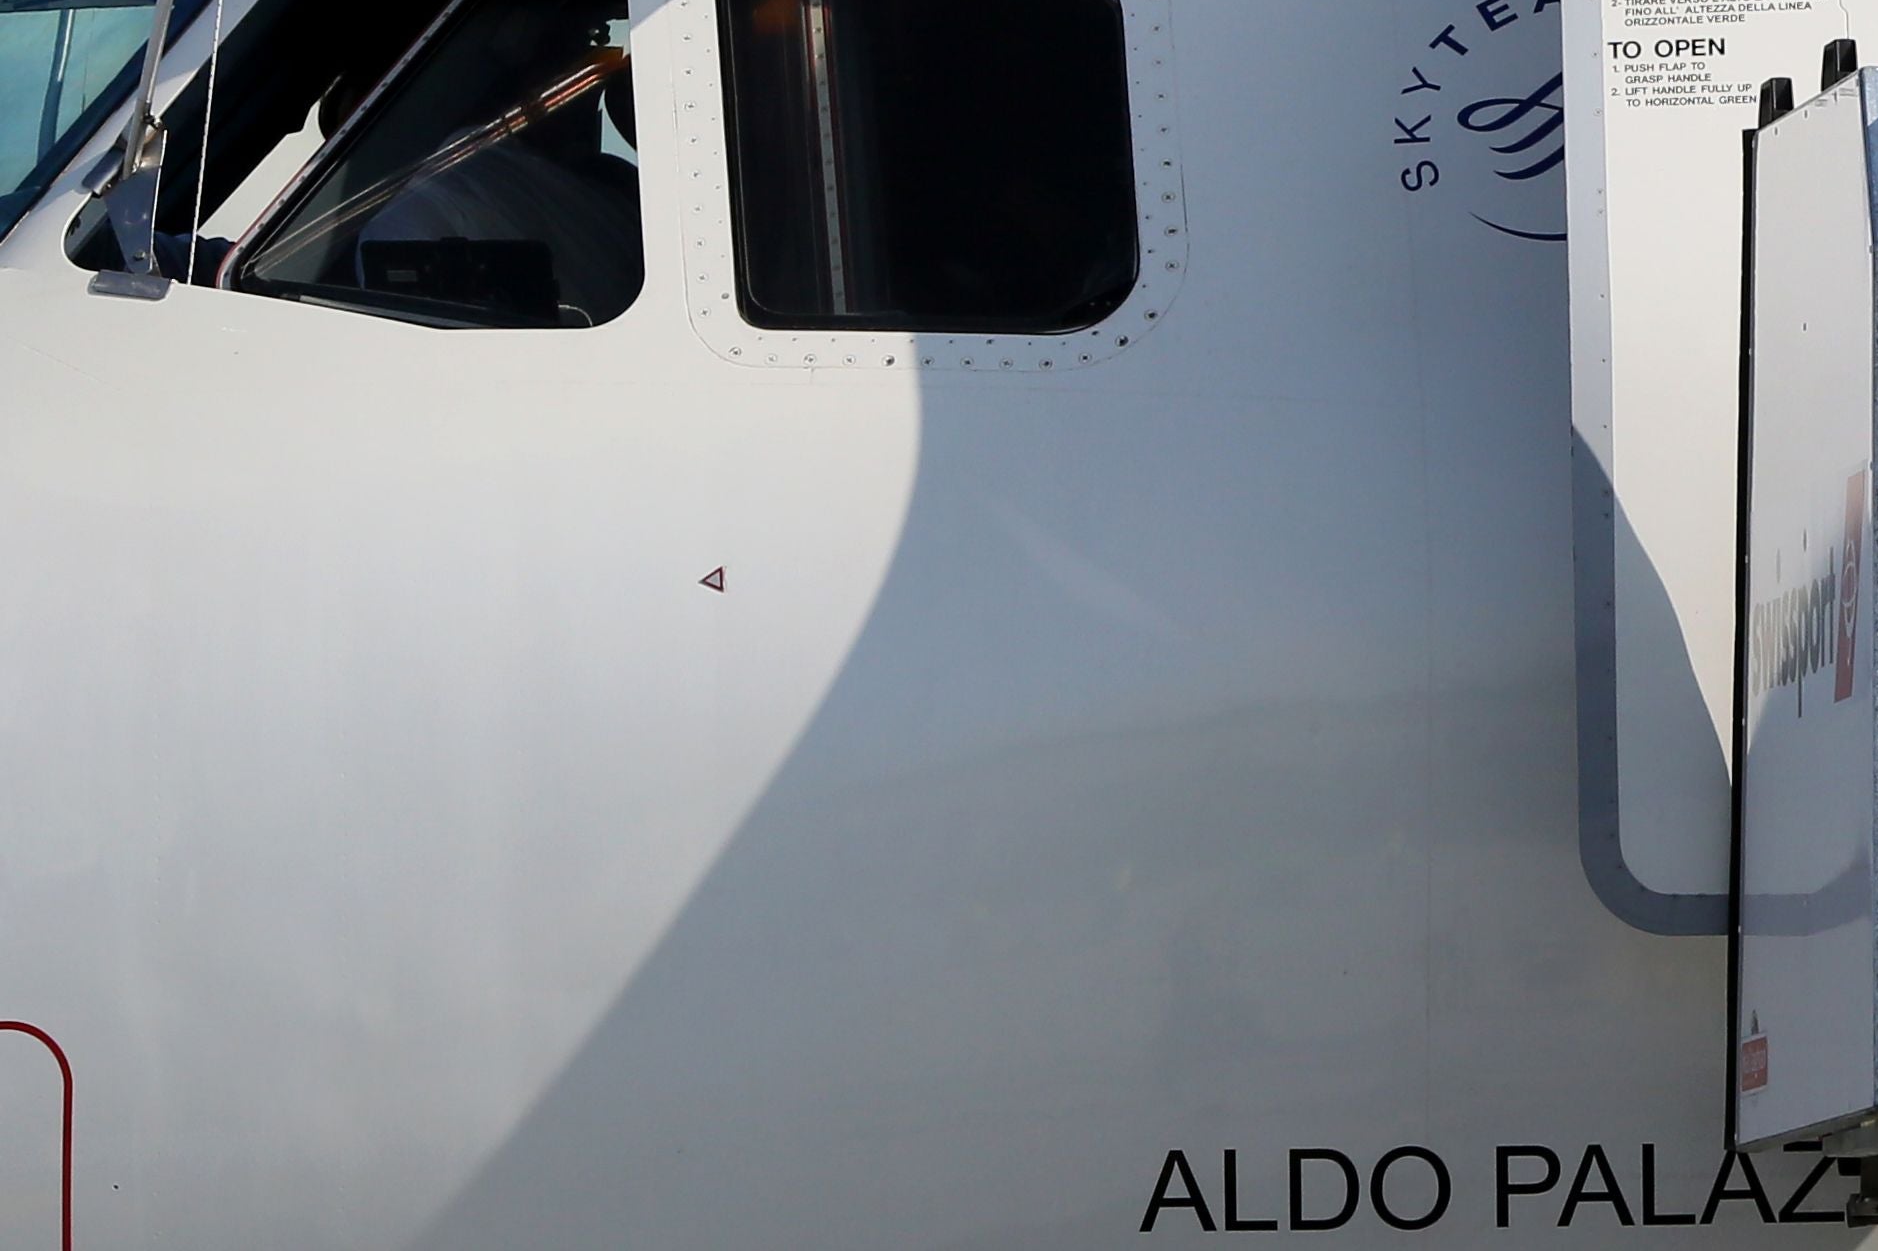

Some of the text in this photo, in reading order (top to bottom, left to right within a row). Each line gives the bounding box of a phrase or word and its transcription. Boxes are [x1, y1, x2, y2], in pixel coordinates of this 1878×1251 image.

[1625, 6, 1652, 16] FINO
[1684, 3, 1736, 14] ALTEZZA
[1738, 2, 1776, 12] DELLA
[1778, 1, 1812, 11] LINEA
[1624, 13, 1746, 27] ORIZZONTALE VERDE
[1607, 38, 1726, 59] TO OPEN
[1624, 63, 1655, 73] PUSH
[1659, 62, 1687, 72] FLAP
[1691, 61, 1706, 71] TO
[1625, 73, 1712, 84] GRASP HANDLE
[1625, 86, 1648, 96] LIFT
[1652, 85, 1696, 95] HANDLE
[1701, 84, 1734, 94] FULLY
[1737, 83, 1752, 93] UP
[1626, 95, 1757, 108] TO HORIZONTAL GREEN
[1752, 528, 1836, 719] swissport
[1139, 1145, 1452, 1233] ALDO
